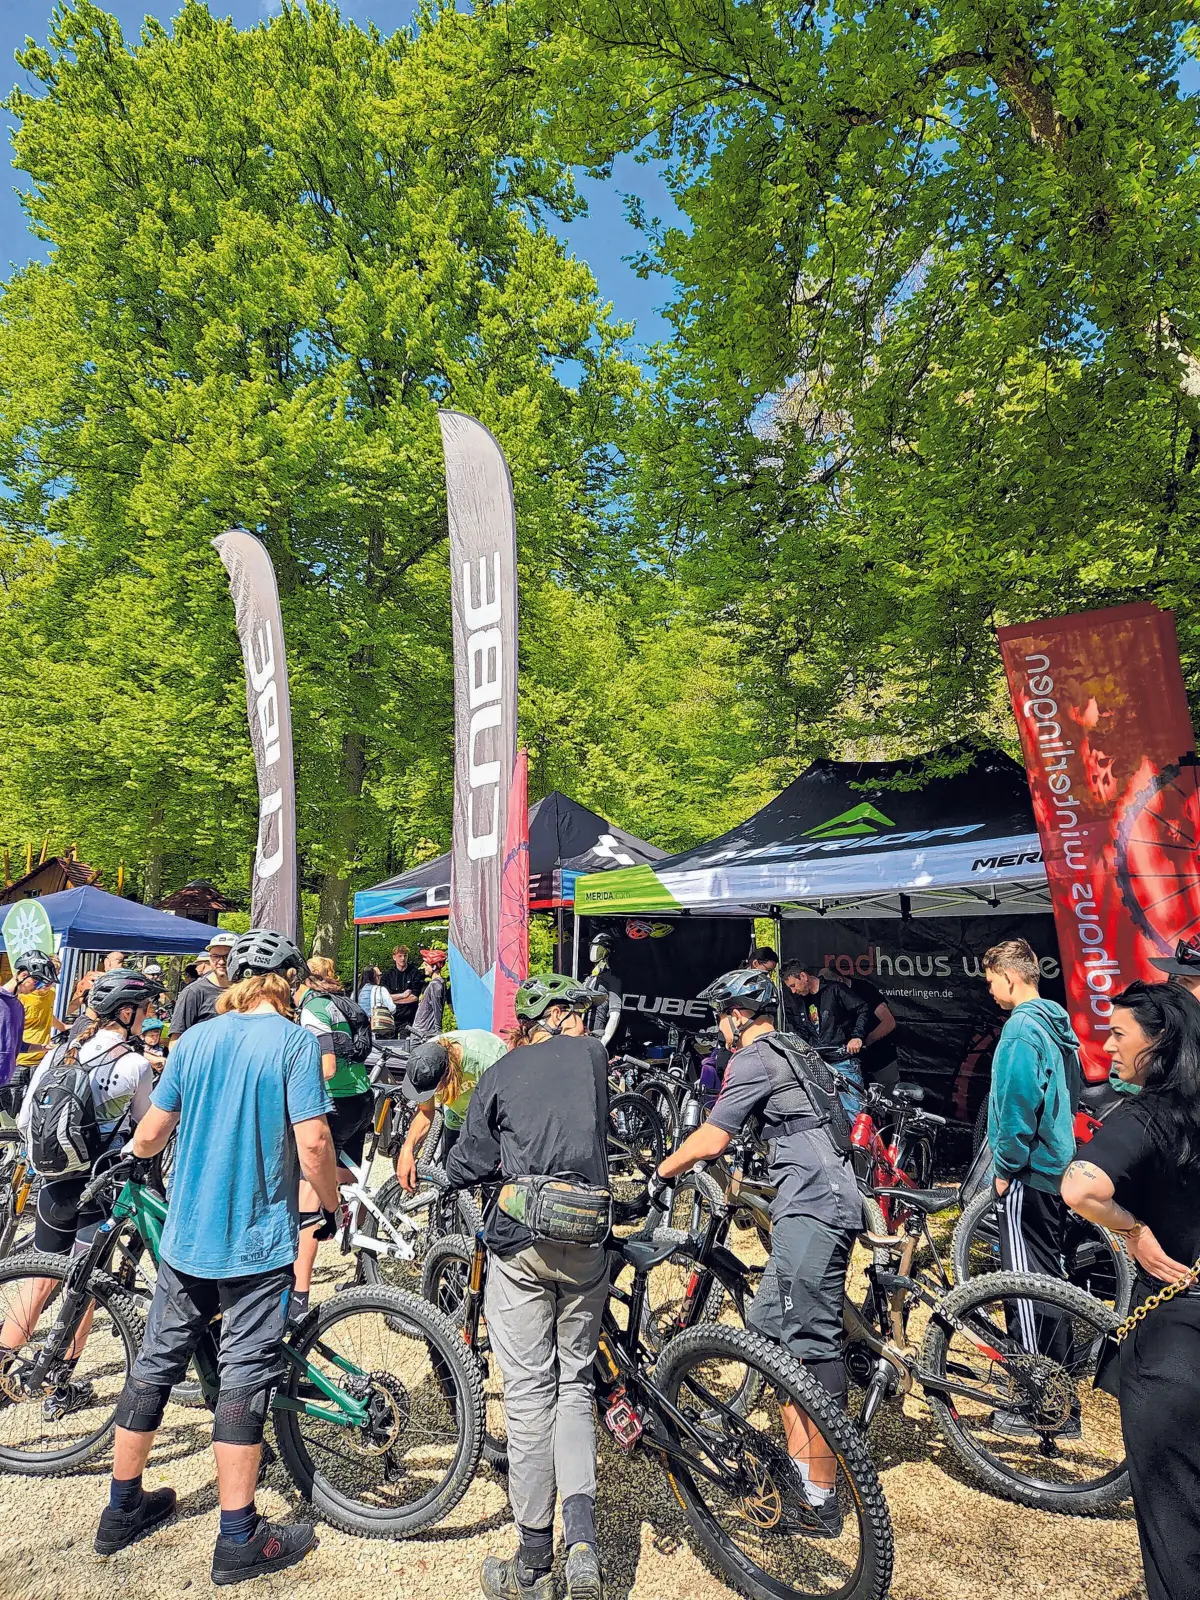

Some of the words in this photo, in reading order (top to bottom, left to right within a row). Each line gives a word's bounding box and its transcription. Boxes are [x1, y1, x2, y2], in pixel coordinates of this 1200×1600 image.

[700, 823, 986, 864] MERIDA
[585, 891, 631, 901] MERIDA.com
[824, 946, 951, 977] radhaus
[622, 993, 709, 1018] CUBE
[879, 987, 953, 1000] s-winterlingen.de
